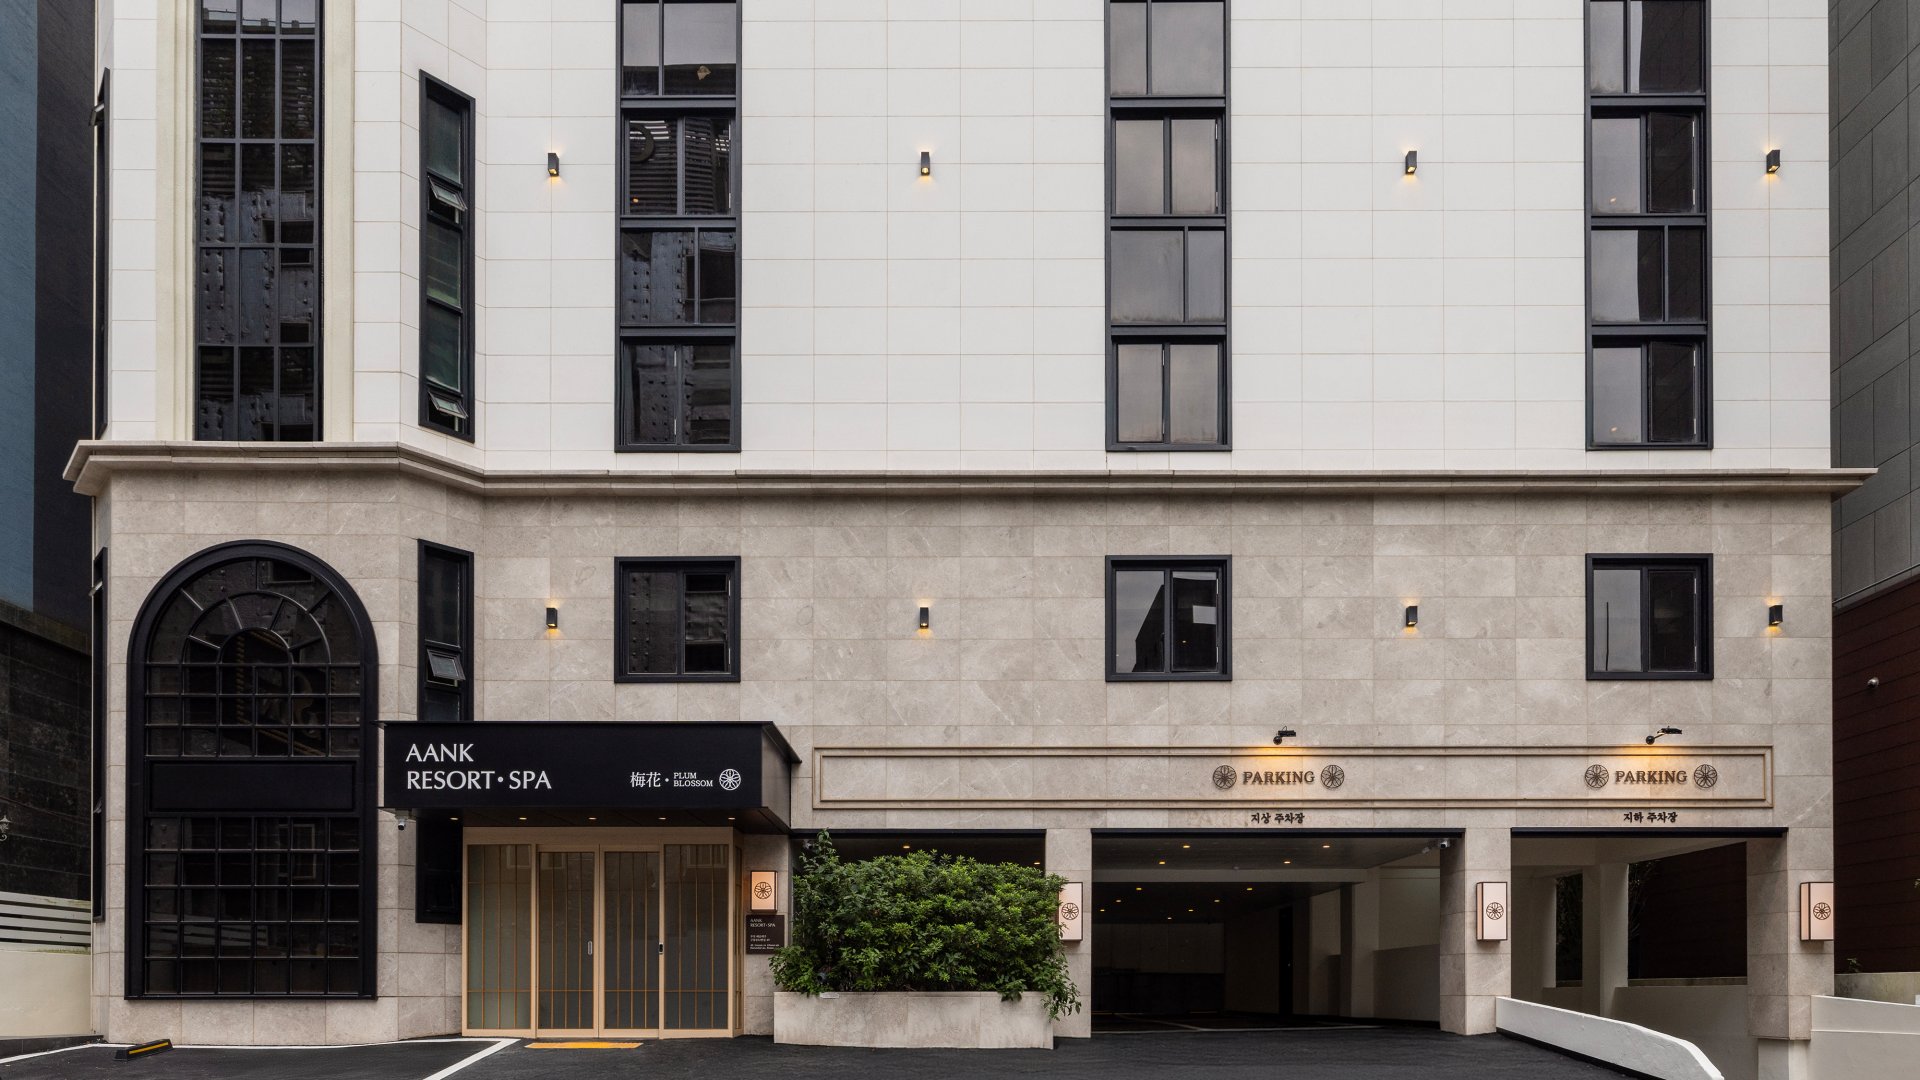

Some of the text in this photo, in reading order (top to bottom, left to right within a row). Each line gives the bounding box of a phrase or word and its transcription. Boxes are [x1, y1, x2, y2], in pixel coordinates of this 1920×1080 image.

[405, 743, 475, 762] AANK
[673, 772, 697, 780] PLUM
[1243, 771, 1315, 785] PARKING
[1614, 770, 1688, 784] PARKING
[673, 780, 714, 788] BLOSSOM
[1251, 812, 1305, 825] 지상 주차장
[1623, 811, 1678, 824] 지하 주차장
